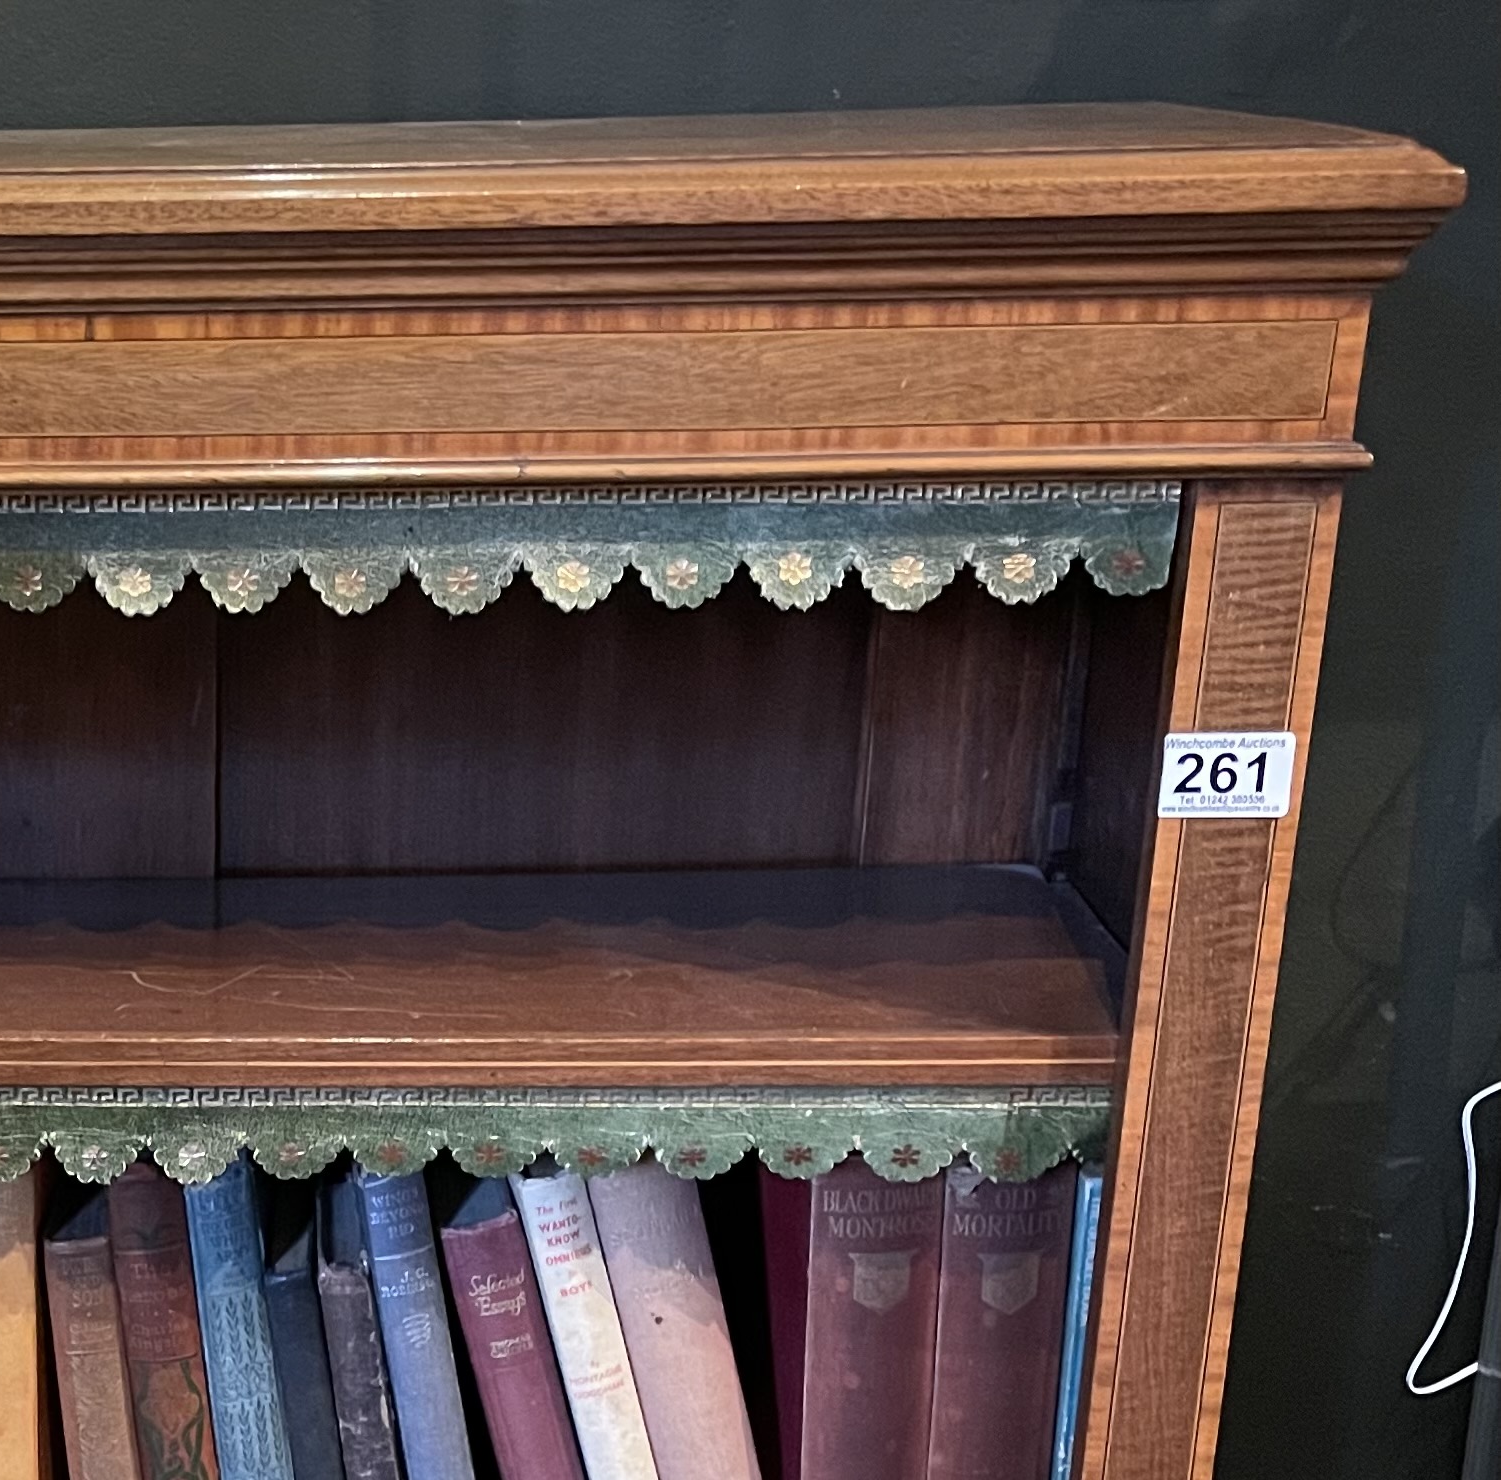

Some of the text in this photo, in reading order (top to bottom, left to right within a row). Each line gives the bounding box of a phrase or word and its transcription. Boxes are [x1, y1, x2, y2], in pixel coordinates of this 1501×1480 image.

[1166, 737, 1286, 749] Winchcombe Auctions
[1173, 751, 1267, 793] 261
[371, 1187, 419, 1209] WINGS
[822, 1189, 881, 1213] BLACK
[995, 1188, 1037, 1211] OLD
[369, 1202, 425, 1225] BEYOND
[536, 1206, 554, 1216] The
[547, 1228, 580, 1247] KNOW
[827, 1213, 936, 1240] MONTROSE
[381, 1279, 437, 1298] ROBINSO
[469, 1267, 525, 1297] Selected
[475, 1291, 527, 1316] Essays
